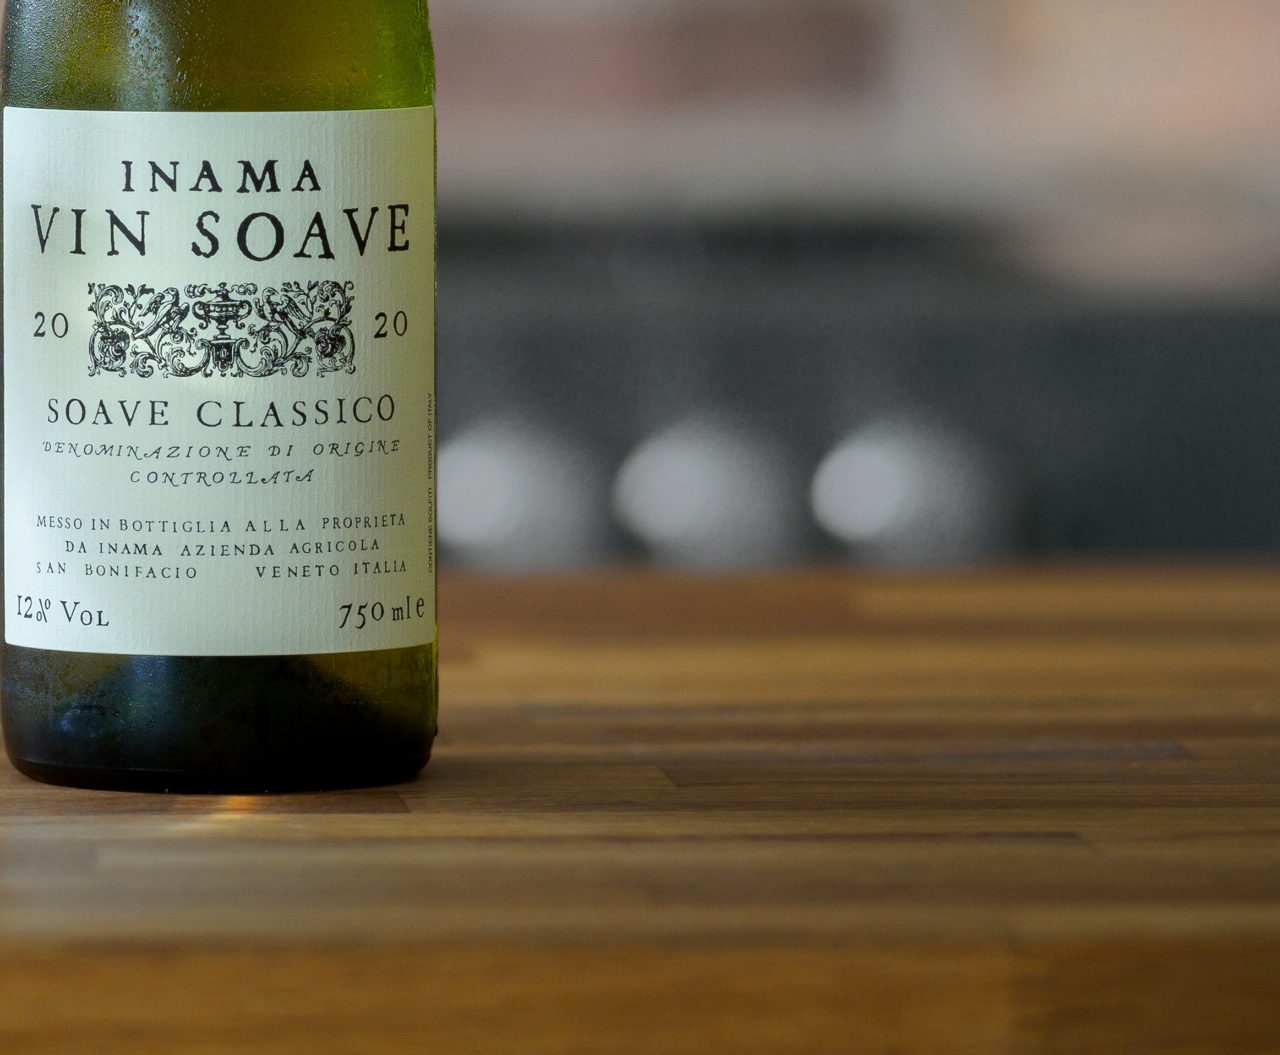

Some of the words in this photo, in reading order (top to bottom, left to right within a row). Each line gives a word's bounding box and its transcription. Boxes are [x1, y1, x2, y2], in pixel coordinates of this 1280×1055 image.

[120, 158, 322, 194] INAMA
[30, 203, 151, 257] VIN
[190, 203, 410, 263] SOAVE
[32, 310, 70, 339] 20
[373, 310, 408, 340] 20
[47, 397, 169, 428] SOAVE
[195, 393, 395, 428] CLASSICO
[42, 440, 252, 462] DENOMINAZIONE
[267, 444, 294, 457] DI
[312, 439, 400, 458] ORIGINE
[129, 468, 315, 488] CONTROLLATA
[36, 514, 83, 530] MESSO
[91, 518, 111, 531] IN
[119, 518, 231, 534] BOTTIGLIA
[244, 518, 306, 533] ALLA
[321, 512, 406, 530] PROPRIETA
[64, 539, 88, 554] DA
[98, 542, 163, 557] INAMA
[179, 543, 275, 557] AZIENDA
[288, 538, 380, 555] AGRICOLA
[35, 561, 67, 575] SAN
[84, 563, 197, 579] BONIFACIO
[255, 564, 340, 579] VENETO
[353, 559, 407, 576] ITALIA
[338, 601, 385, 630] 750
